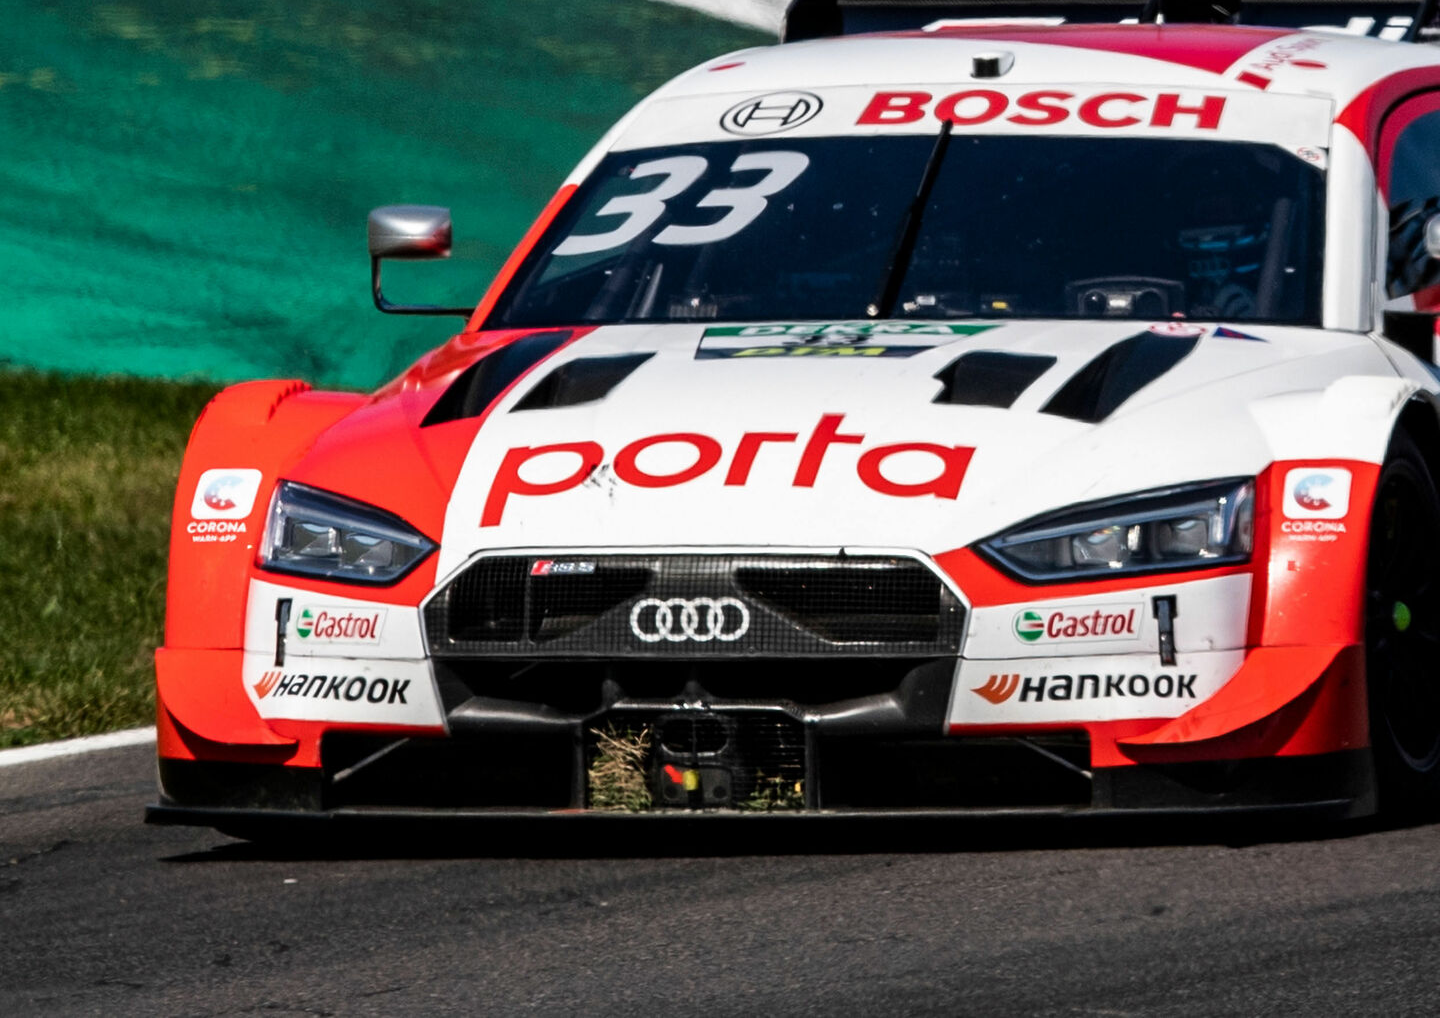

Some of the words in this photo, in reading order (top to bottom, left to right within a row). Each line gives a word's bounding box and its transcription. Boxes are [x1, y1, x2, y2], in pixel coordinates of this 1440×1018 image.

[855, 88, 1228, 131] BOSCH
[551, 150, 810, 256] 33
[480, 413, 977, 528] porta
[186, 521, 247, 534] CORONA
[1281, 522, 1347, 533] CORONA
[314, 611, 379, 638] Castrol
[1046, 608, 1136, 638] Castrol
